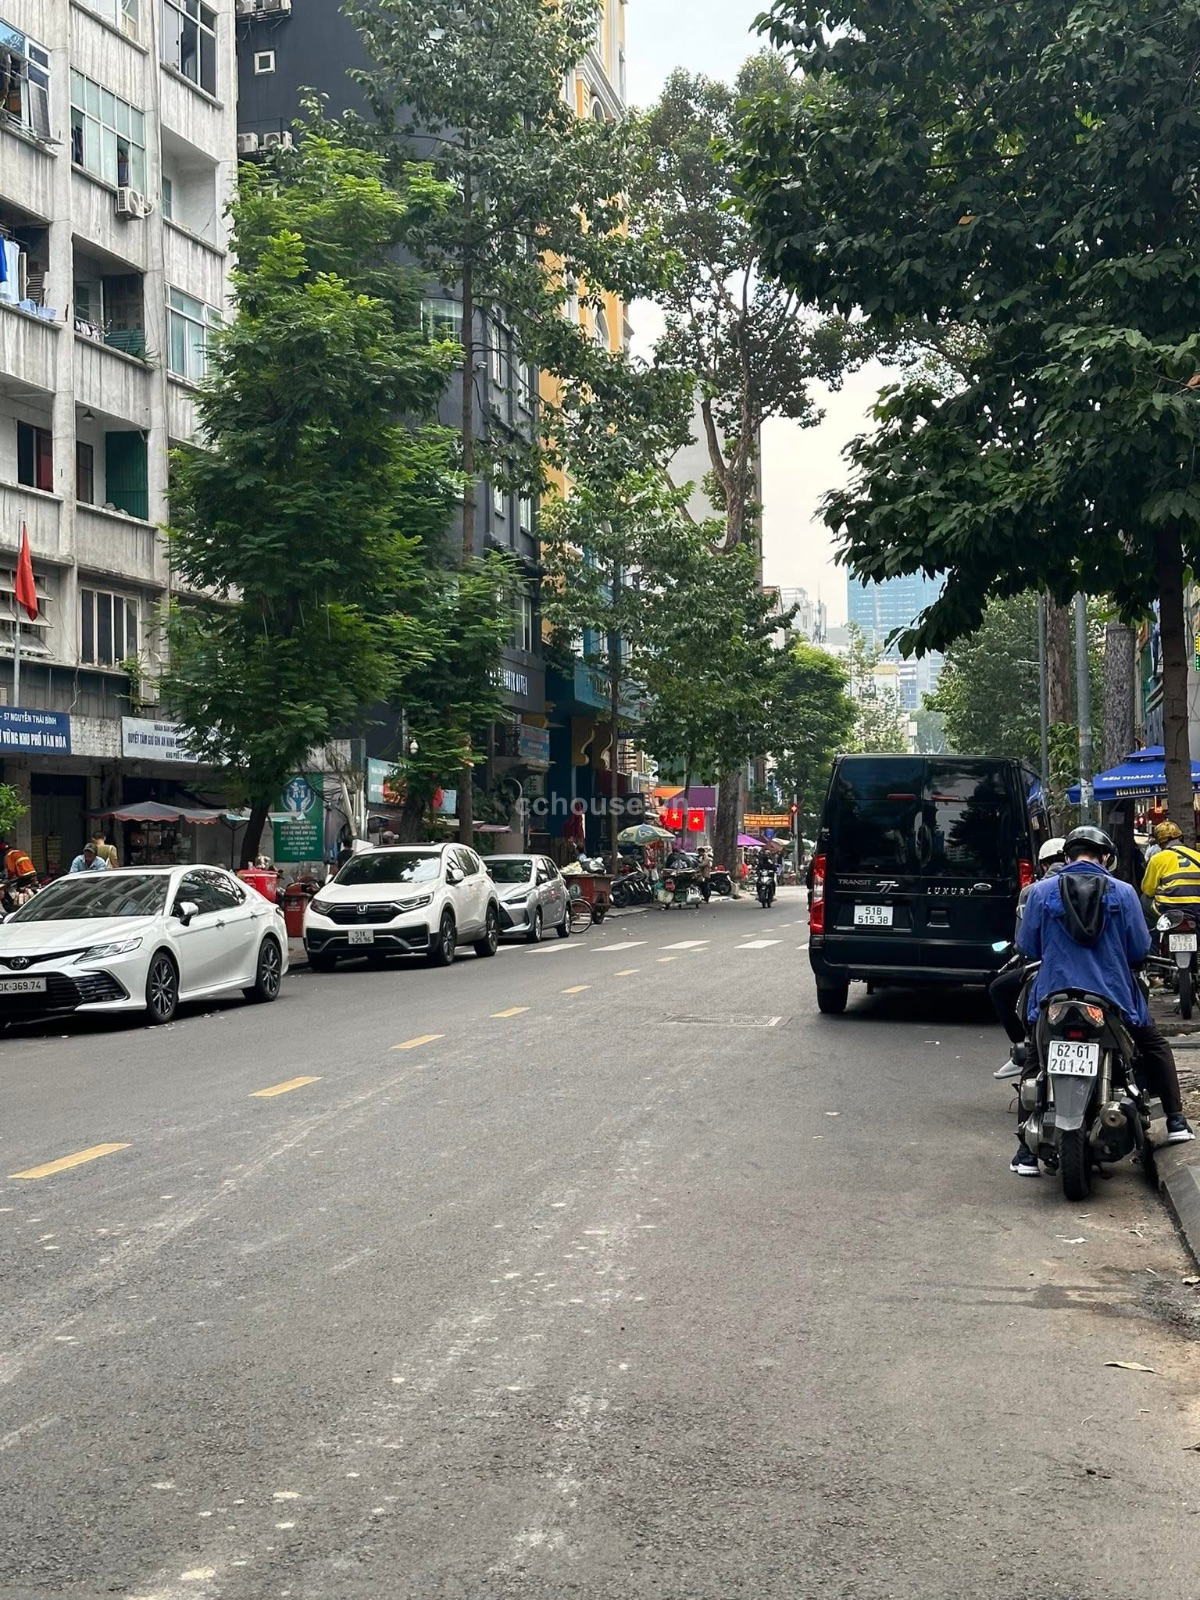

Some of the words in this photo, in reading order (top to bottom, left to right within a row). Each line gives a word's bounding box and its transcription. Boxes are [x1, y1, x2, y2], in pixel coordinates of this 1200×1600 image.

[1115, 787, 1151, 796] Hotline
[927, 886, 974, 895] LUXURY
[865, 906, 882, 915] 51B
[858, 915, 889, 924] 515.38
[1051, 1059, 1094, 1074] 201.41
